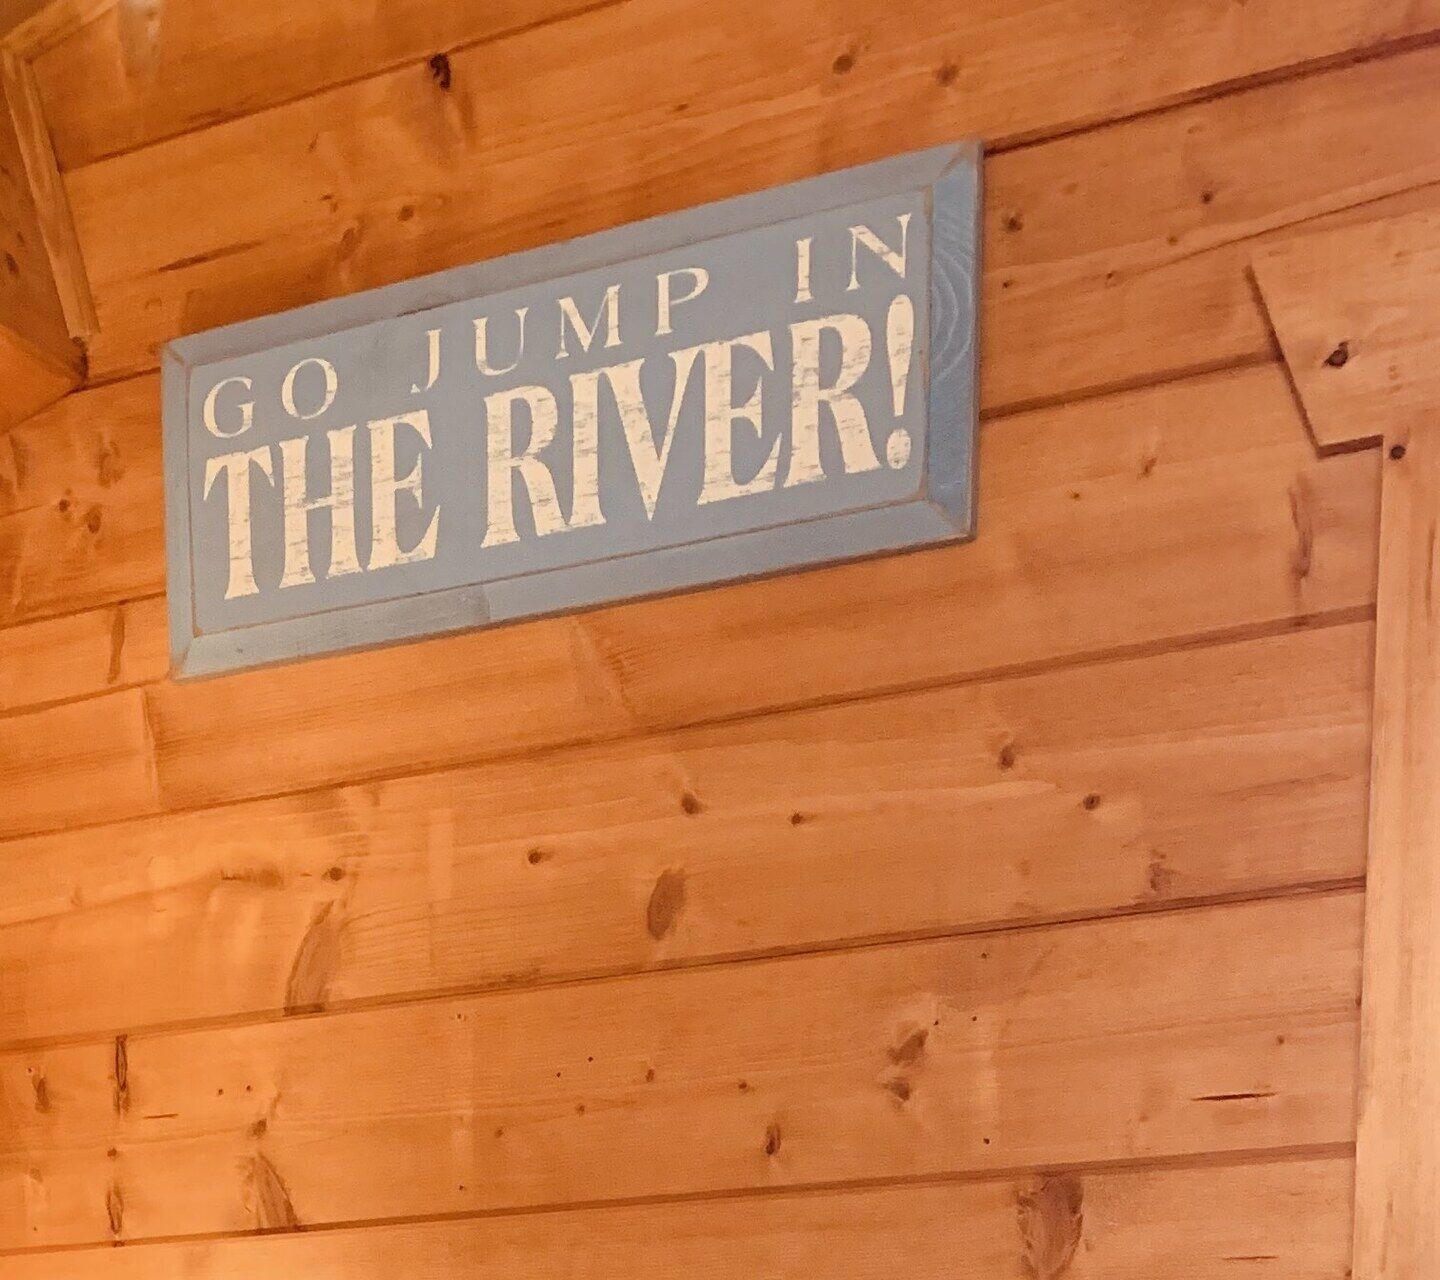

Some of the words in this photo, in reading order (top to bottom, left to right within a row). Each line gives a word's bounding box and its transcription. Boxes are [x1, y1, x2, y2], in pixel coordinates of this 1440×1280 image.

[202, 357, 338, 438] GO
[410, 266, 709, 394] JUMP
[794, 212, 914, 304] IN
[203, 408, 441, 601] THE
[480, 294, 915, 549] RIVER!
